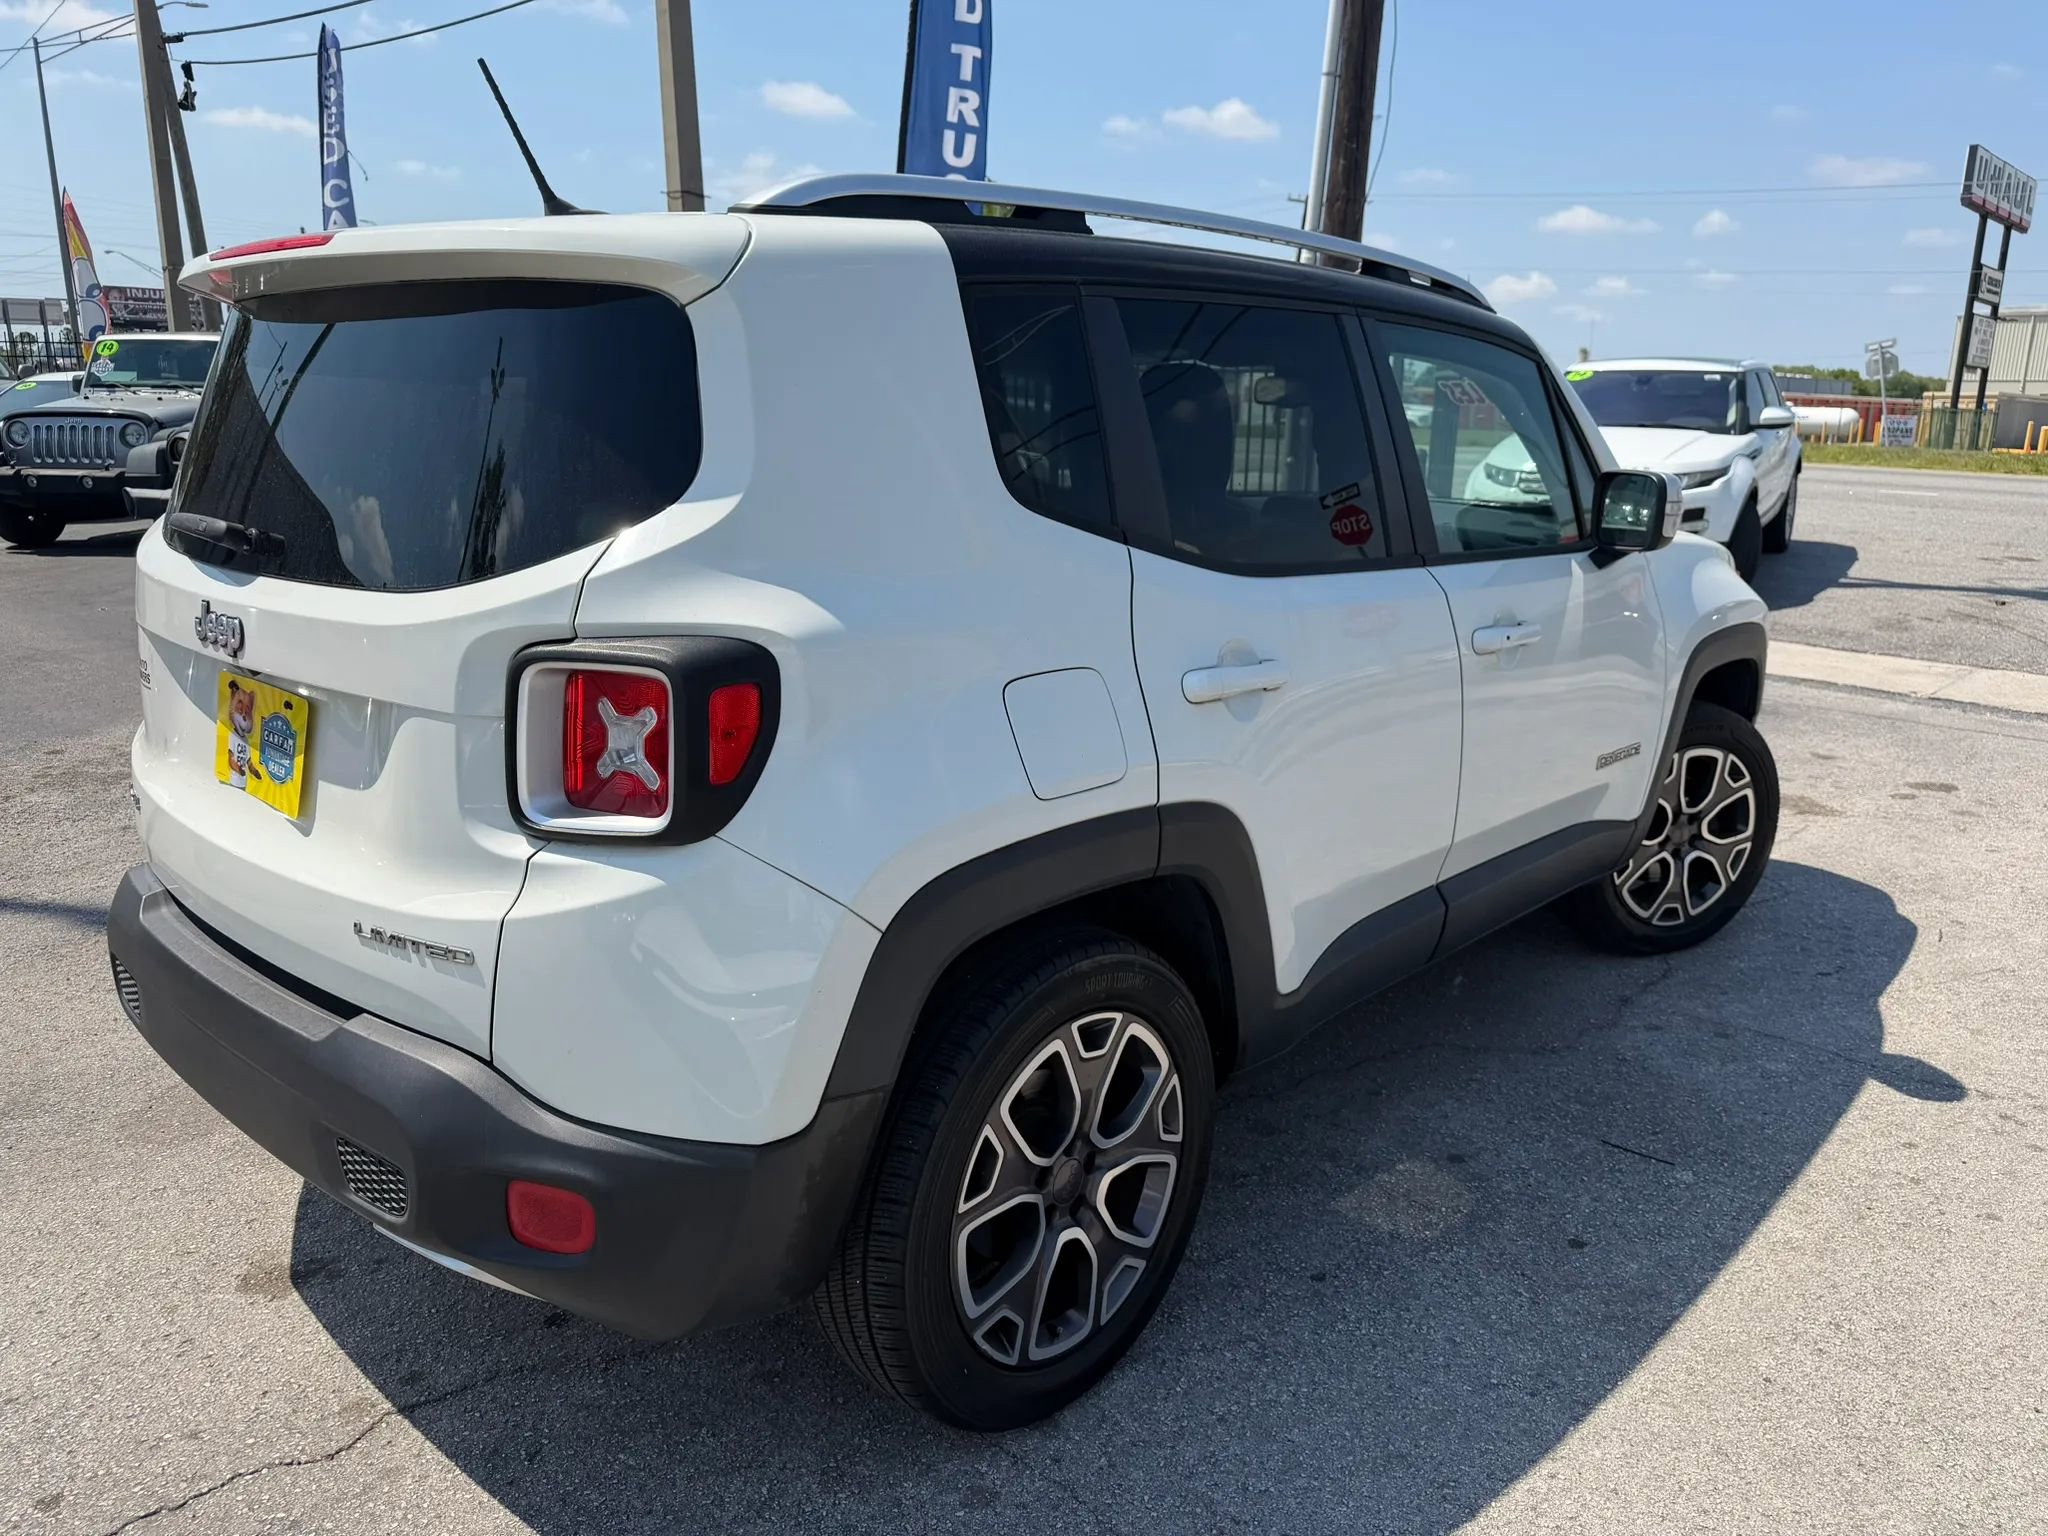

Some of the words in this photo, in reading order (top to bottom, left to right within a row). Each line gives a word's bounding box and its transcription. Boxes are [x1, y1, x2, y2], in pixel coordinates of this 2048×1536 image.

[942, 43, 982, 181] TRU
[101, 343, 114, 353] 14
[195, 600, 245, 658] Jeep
[353, 919, 475, 966] LIMITED
[1084, 973, 1112, 993] SPORT
